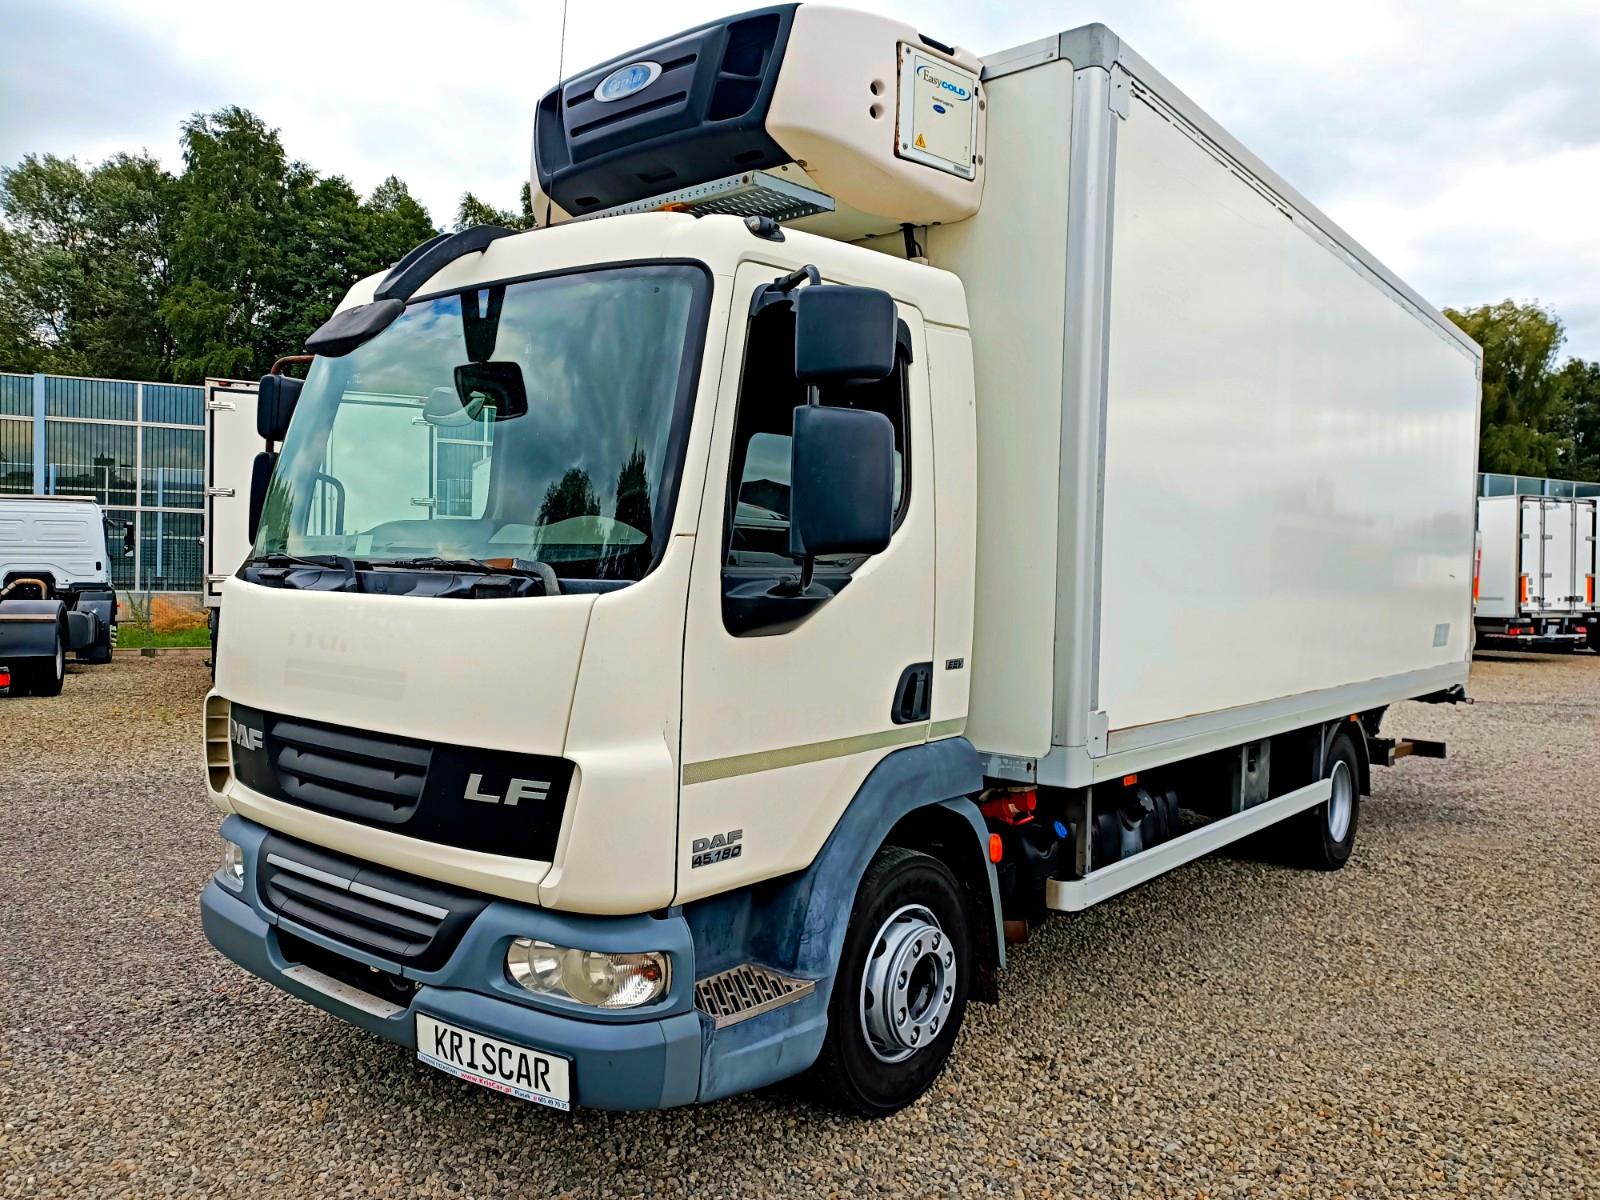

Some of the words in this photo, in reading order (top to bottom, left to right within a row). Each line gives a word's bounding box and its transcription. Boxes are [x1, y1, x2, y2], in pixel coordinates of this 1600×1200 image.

[923, 69, 966, 96] EasyCOLD
[463, 773, 552, 804] LF
[692, 829, 743, 854] DAF
[692, 844, 742, 869] 45.180
[435, 1025, 551, 1092] KRISCAR
[460, 1071, 512, 1094] www.KrisCar.pl
